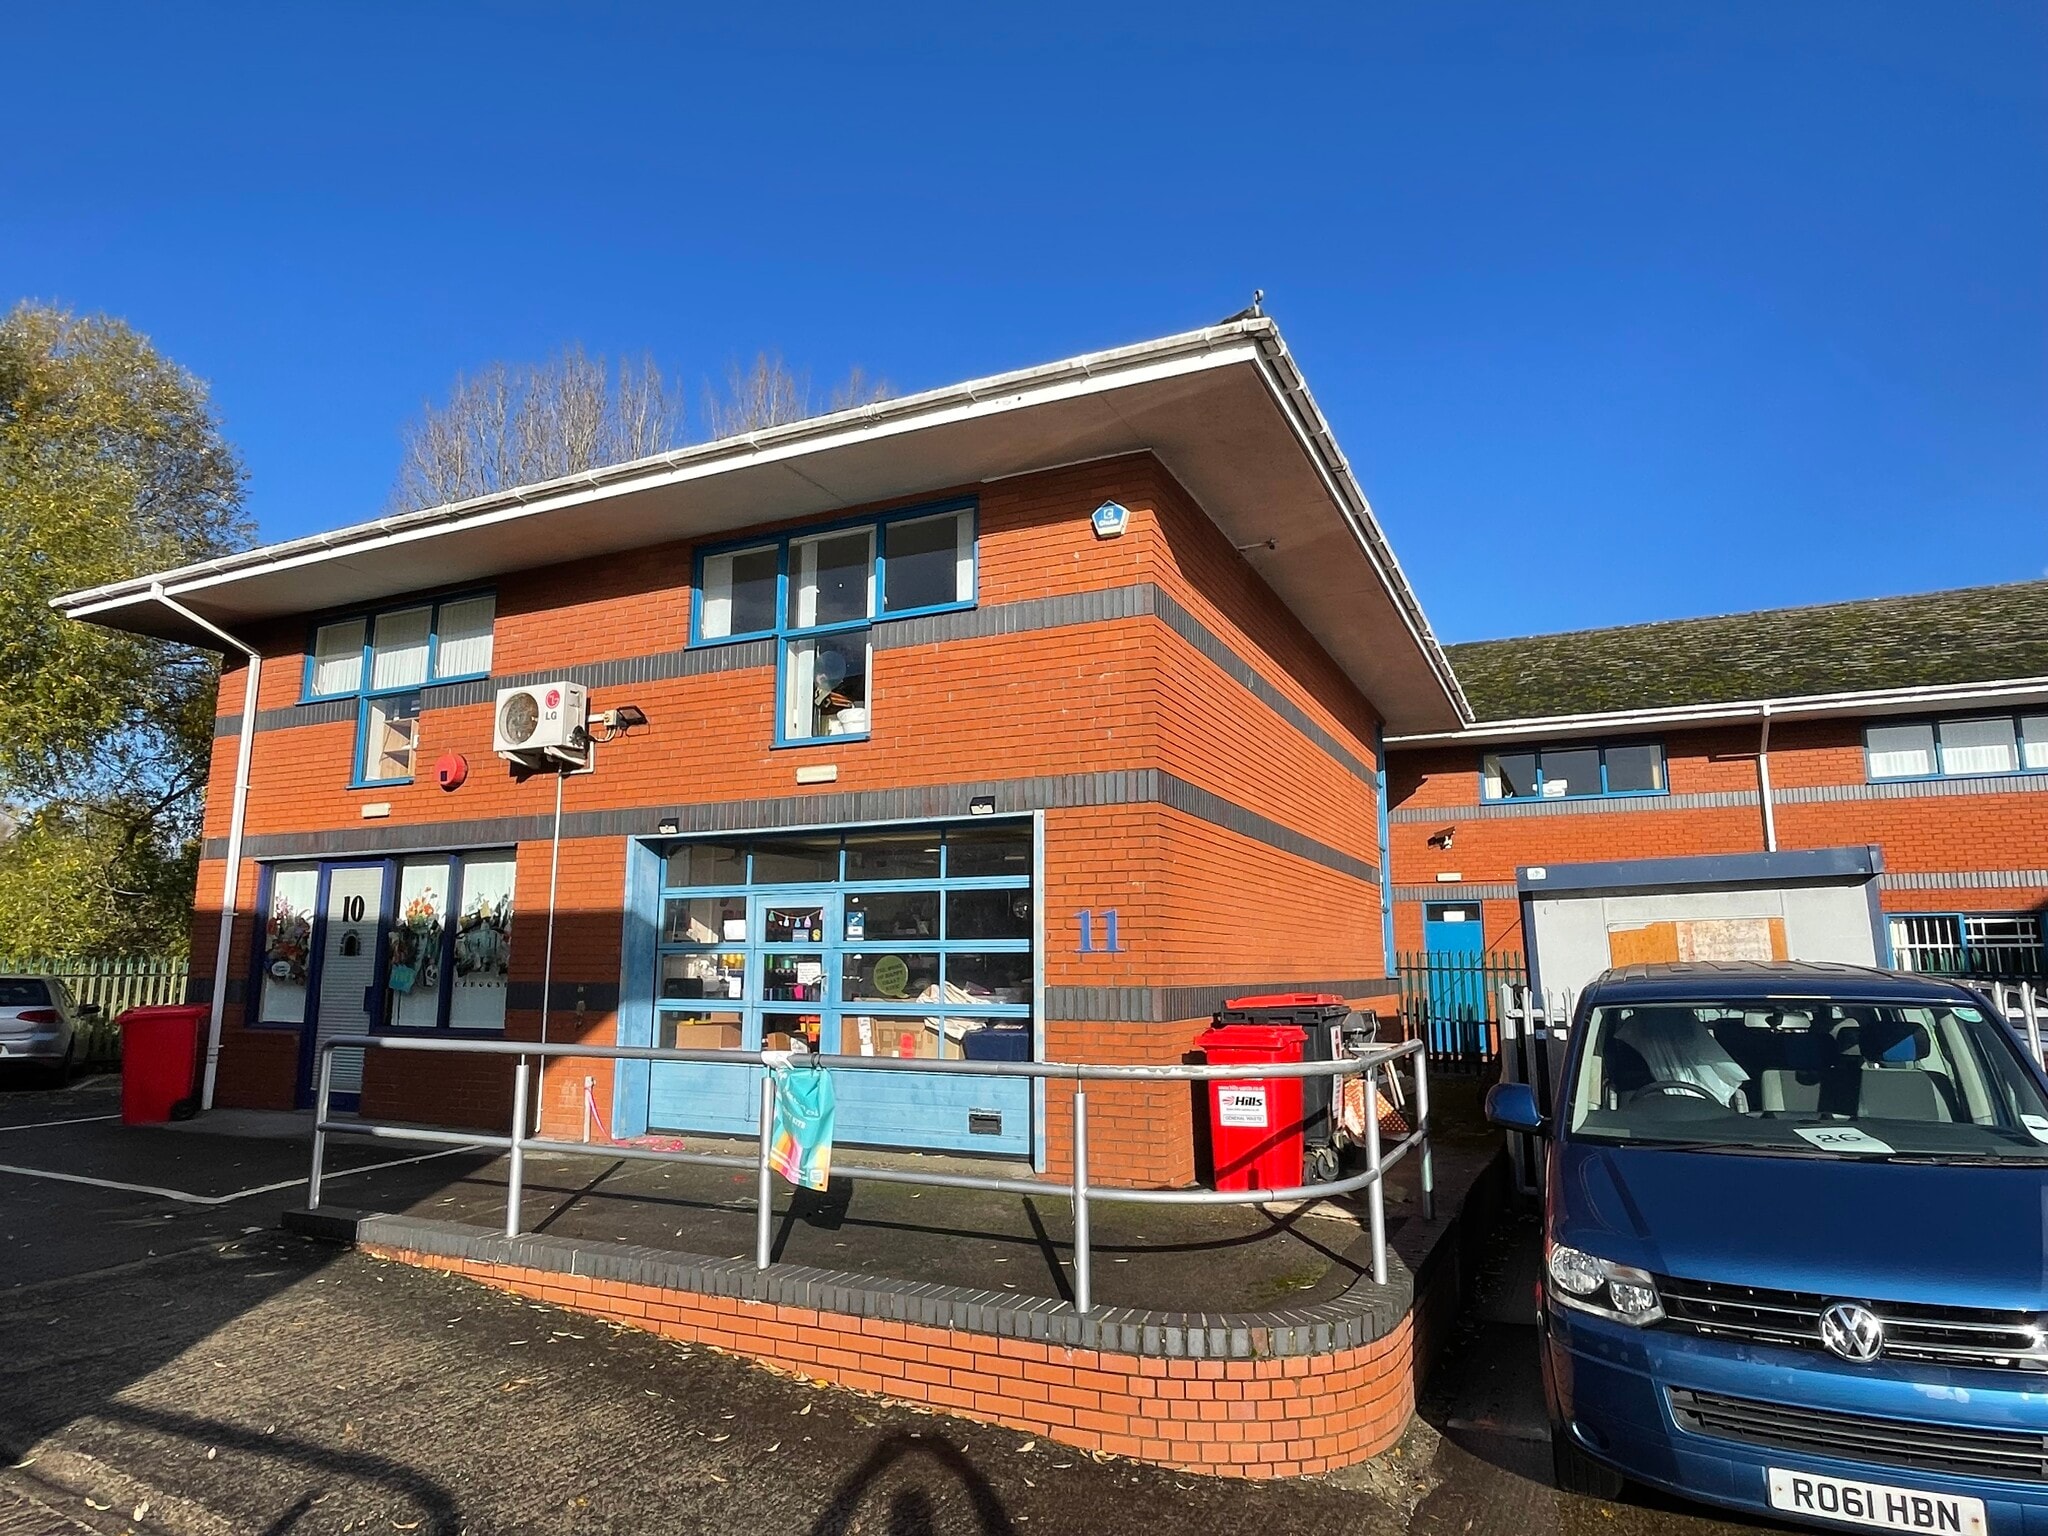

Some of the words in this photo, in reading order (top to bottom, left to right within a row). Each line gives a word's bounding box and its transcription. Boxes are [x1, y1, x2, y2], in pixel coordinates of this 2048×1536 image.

[545, 711, 557, 721] LG
[343, 895, 365, 923] 10
[1073, 908, 1126, 953] 11
[1235, 1096, 1263, 1106] Hills
[1792, 1477, 1875, 1520] RO61
[1884, 1492, 1962, 1533] HBN
